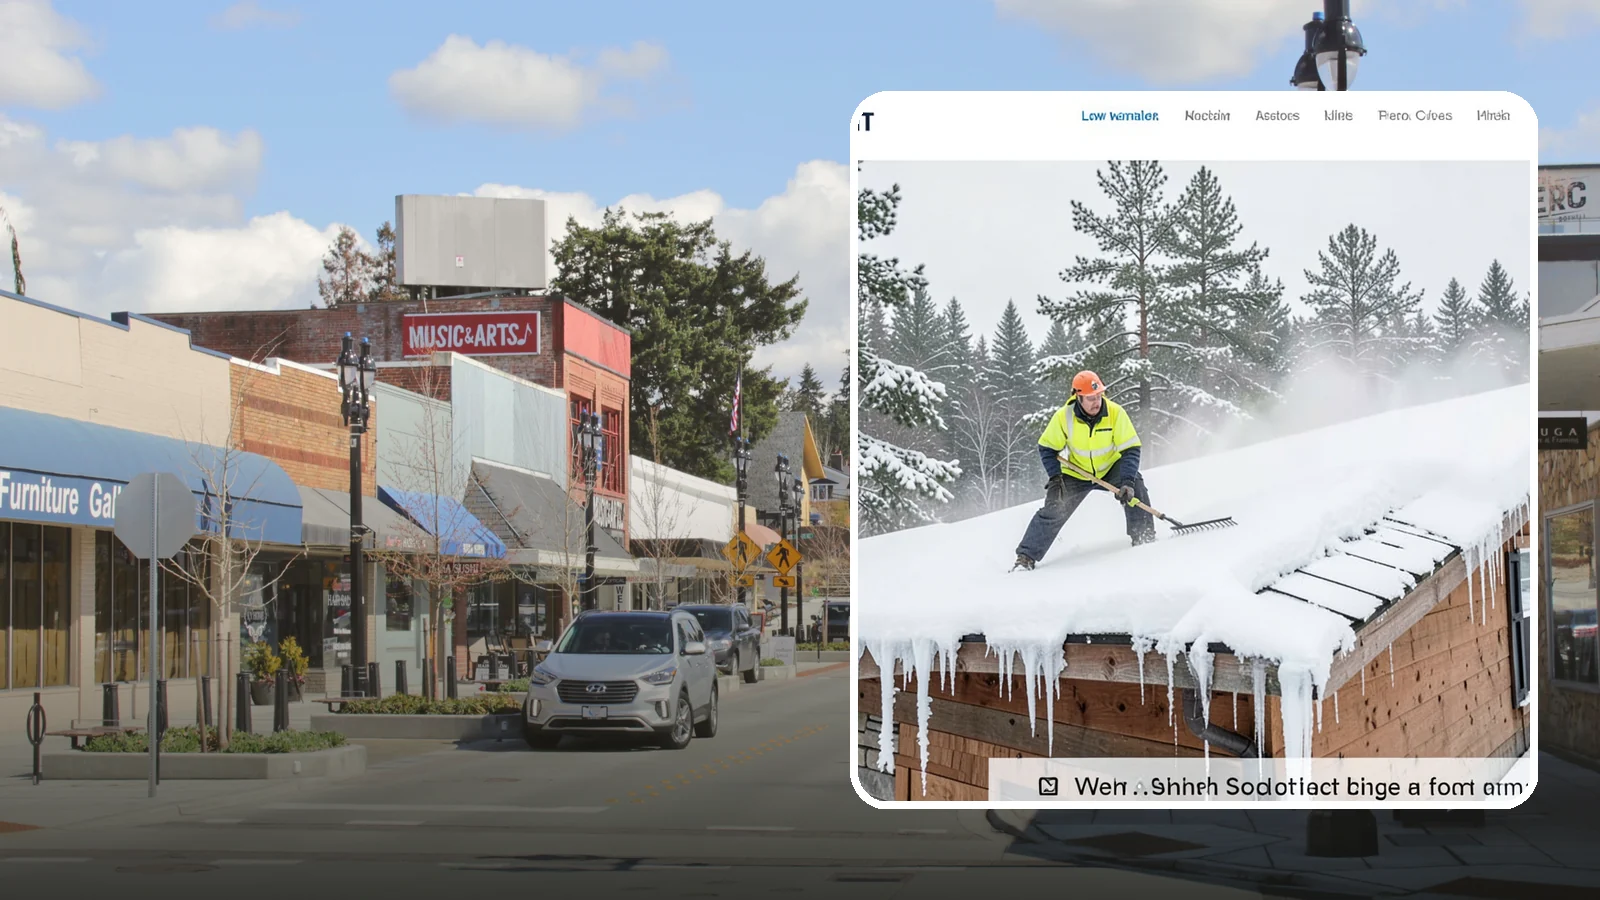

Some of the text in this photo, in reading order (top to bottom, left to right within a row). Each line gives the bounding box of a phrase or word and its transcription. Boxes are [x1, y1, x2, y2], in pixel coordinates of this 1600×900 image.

[408, 323, 519, 349] MUSIC&ARTS
[0, 471, 79, 515] Furniture
[453, 563, 479, 573] SUSHI
